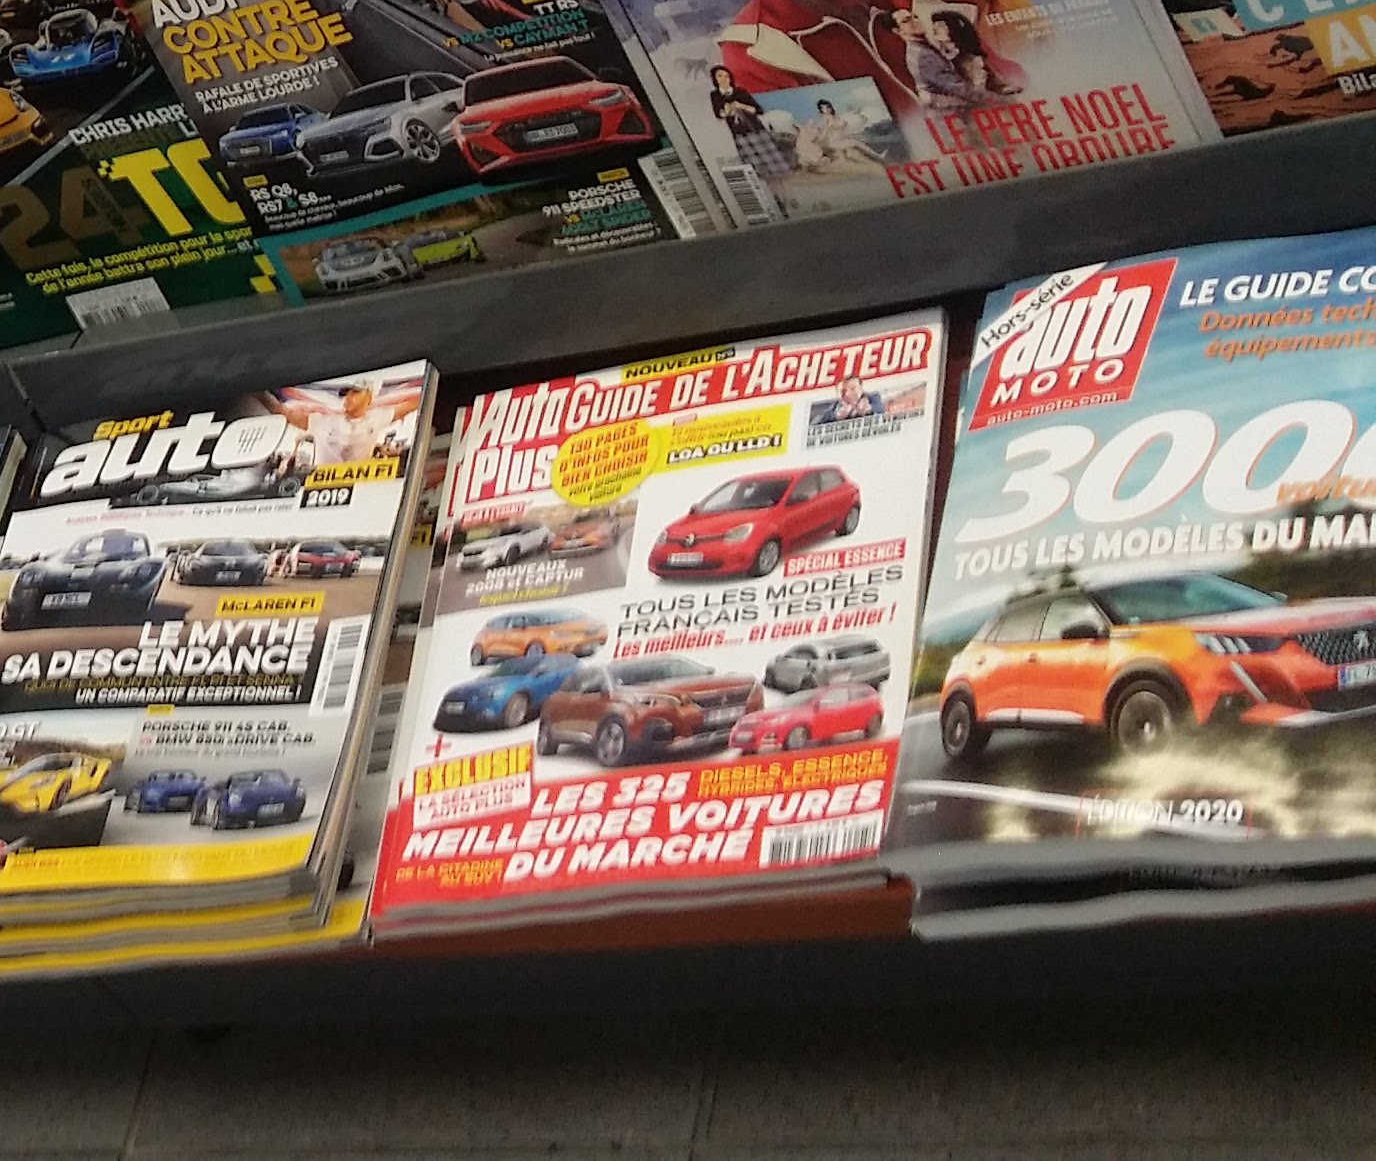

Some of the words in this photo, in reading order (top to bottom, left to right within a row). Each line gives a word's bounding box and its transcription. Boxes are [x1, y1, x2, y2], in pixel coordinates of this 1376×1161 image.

[184, 13, 352, 84] ATTAQUE
[196, 84, 244, 104] RAFALE
[263, 57, 339, 88] SPORTIVES
[1179, 278, 1215, 307] LE
[1224, 271, 1330, 302] GUIDE
[982, 274, 1075, 349] Hors-série
[1200, 304, 1312, 331] Données
[626, 353, 714, 378] NOUVEAU
[991, 364, 1125, 406] MOTO
[93, 410, 175, 439] Sport
[987, 391, 1118, 426] auto-moto.com
[40, 410, 287, 498] auto
[312, 465, 369, 484] BILAN
[306, 487, 349, 507] 2019
[786, 554, 842, 574] SPÉCIAL
[844, 543, 903, 566] ESSENCE
[955, 539, 1031, 582] TOUS
[1036, 533, 1084, 566] LES
[1092, 514, 1244, 560] MODÈLES
[1251, 515, 1306, 552] DU
[221, 599, 297, 614] McLAREN
[621, 594, 695, 619] TOUS
[704, 585, 756, 608] LES
[765, 566, 903, 602] MODÈLES
[138, 620, 184, 648] LE
[190, 617, 320, 647] MYTHE
[618, 607, 758, 638] FRANÇAIS
[771, 590, 879, 619] TESTÉS
[2, 652, 41, 684] SA
[48, 645, 312, 678] DESCENDANCE
[416, 745, 533, 796] EXCLUSIF
[531, 783, 610, 818] LES
[1177, 800, 1243, 823] 2020
[402, 808, 666, 862] MEILLEURES
[669, 779, 884, 833] VOITURES
[503, 847, 562, 883] DU
[568, 825, 753, 876] MARCHÉ
